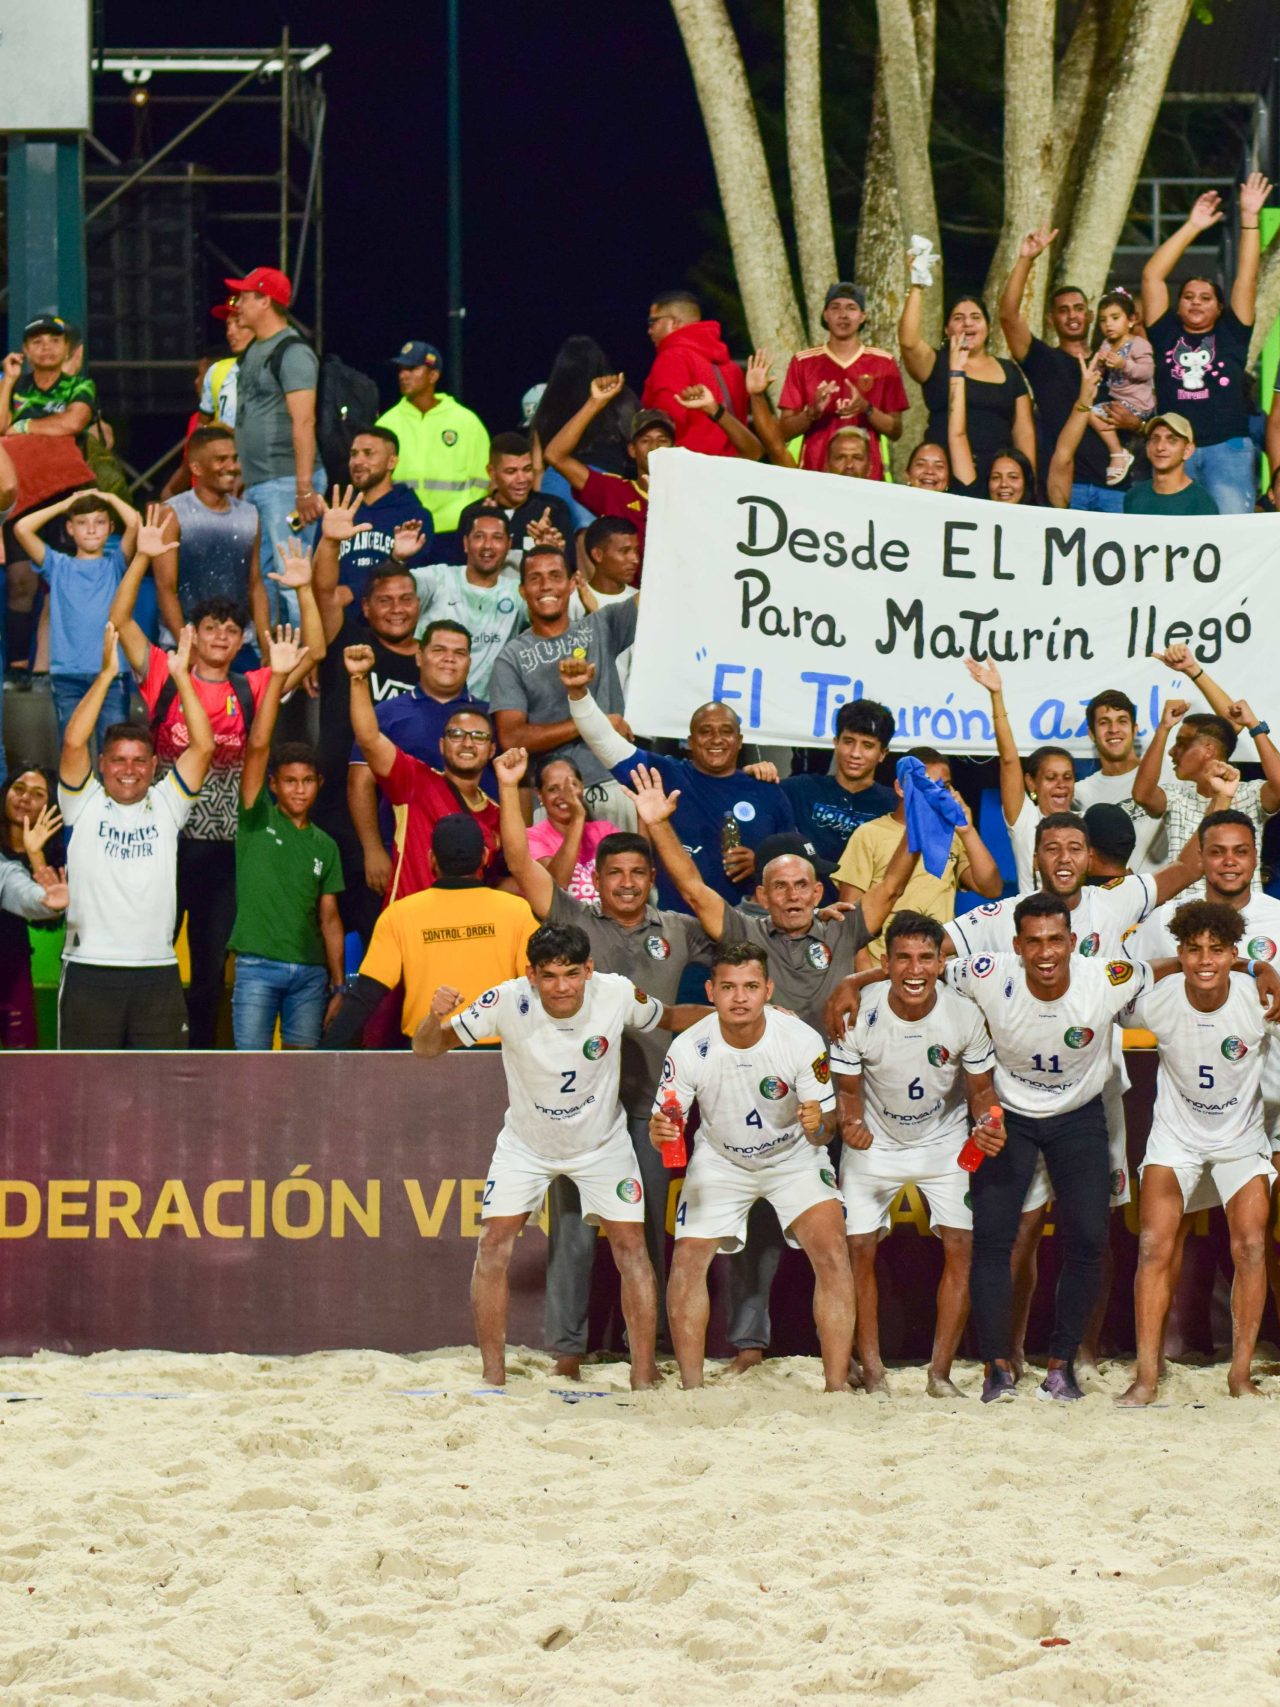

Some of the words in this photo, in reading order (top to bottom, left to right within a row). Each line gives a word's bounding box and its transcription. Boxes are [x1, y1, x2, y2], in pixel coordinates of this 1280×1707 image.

[736, 495, 910, 572] Desde
[942, 521, 1015, 580] EL
[1042, 526, 1222, 587] Morro
[734, 568, 847, 648] Para
[1127, 597, 1252, 664] llegó
[1031, 1053, 1063, 1074] 11
[560, 1070, 576, 1094] 2
[908, 1077, 924, 1100] 6
[1198, 1064, 1214, 1089] 5
[745, 1108, 763, 1129] 4
[0, 1164, 381, 1239] DERACIÓN
[483, 1180, 495, 1206] 2
[676, 1200, 688, 1227] 4
